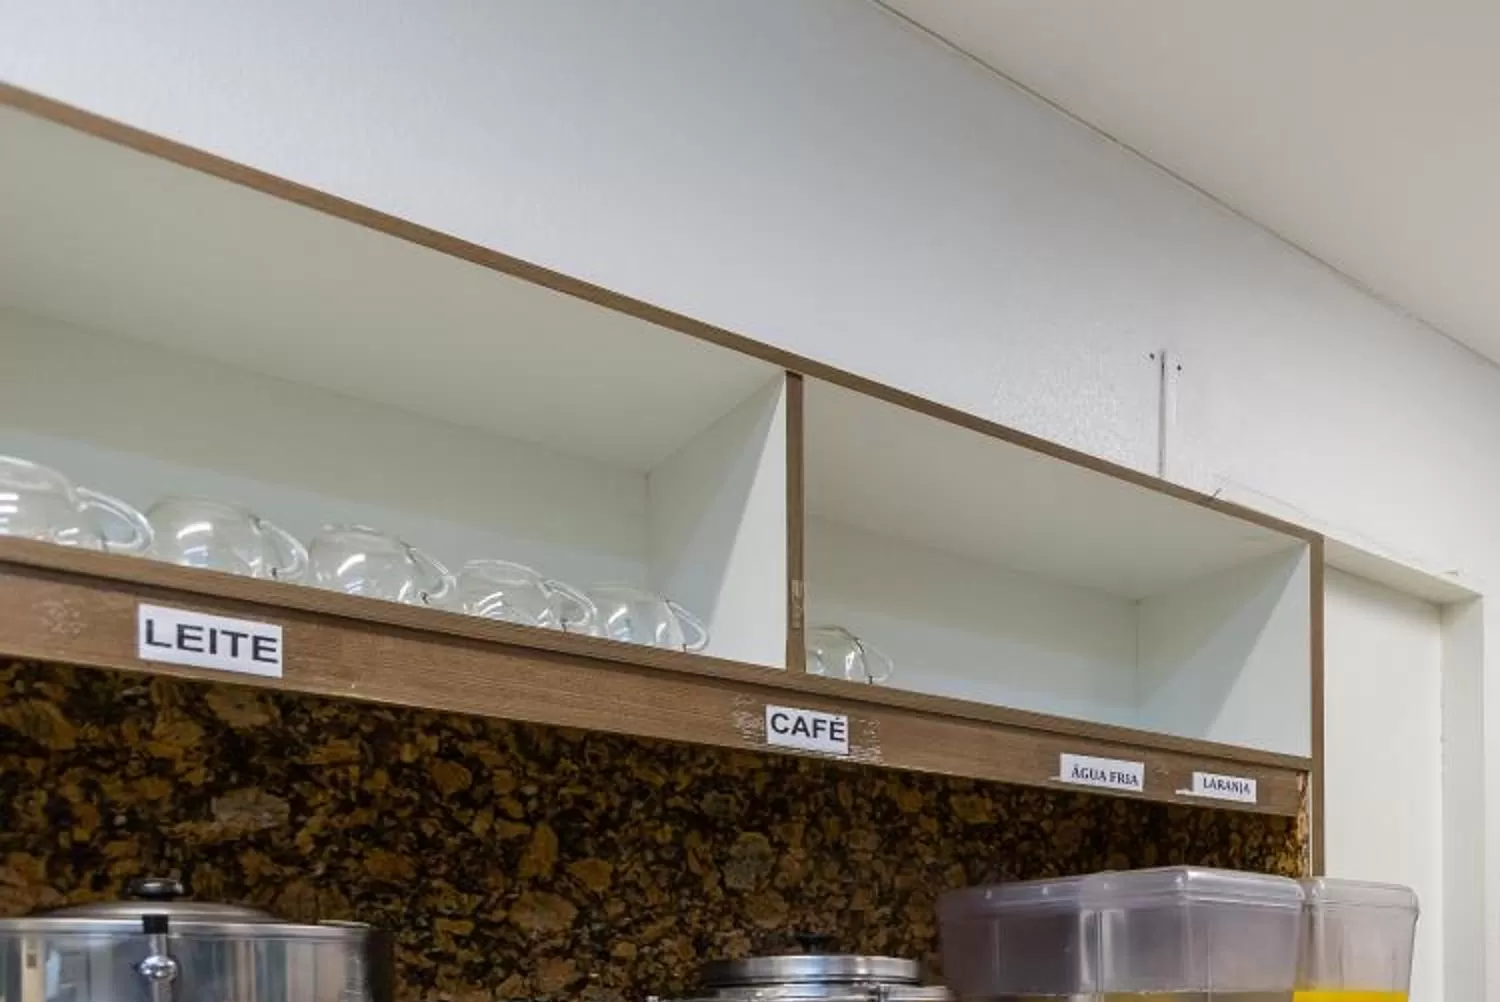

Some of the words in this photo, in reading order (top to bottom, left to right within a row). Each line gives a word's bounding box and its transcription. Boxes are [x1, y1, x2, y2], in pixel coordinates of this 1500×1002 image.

[145, 618, 279, 664] LEITE
[770, 712, 845, 742] CAFÉ
[1071, 763, 1107, 783] ÁGUA
[1109, 769, 1139, 786] FRIA
[1203, 777, 1251, 795] LARANJA
